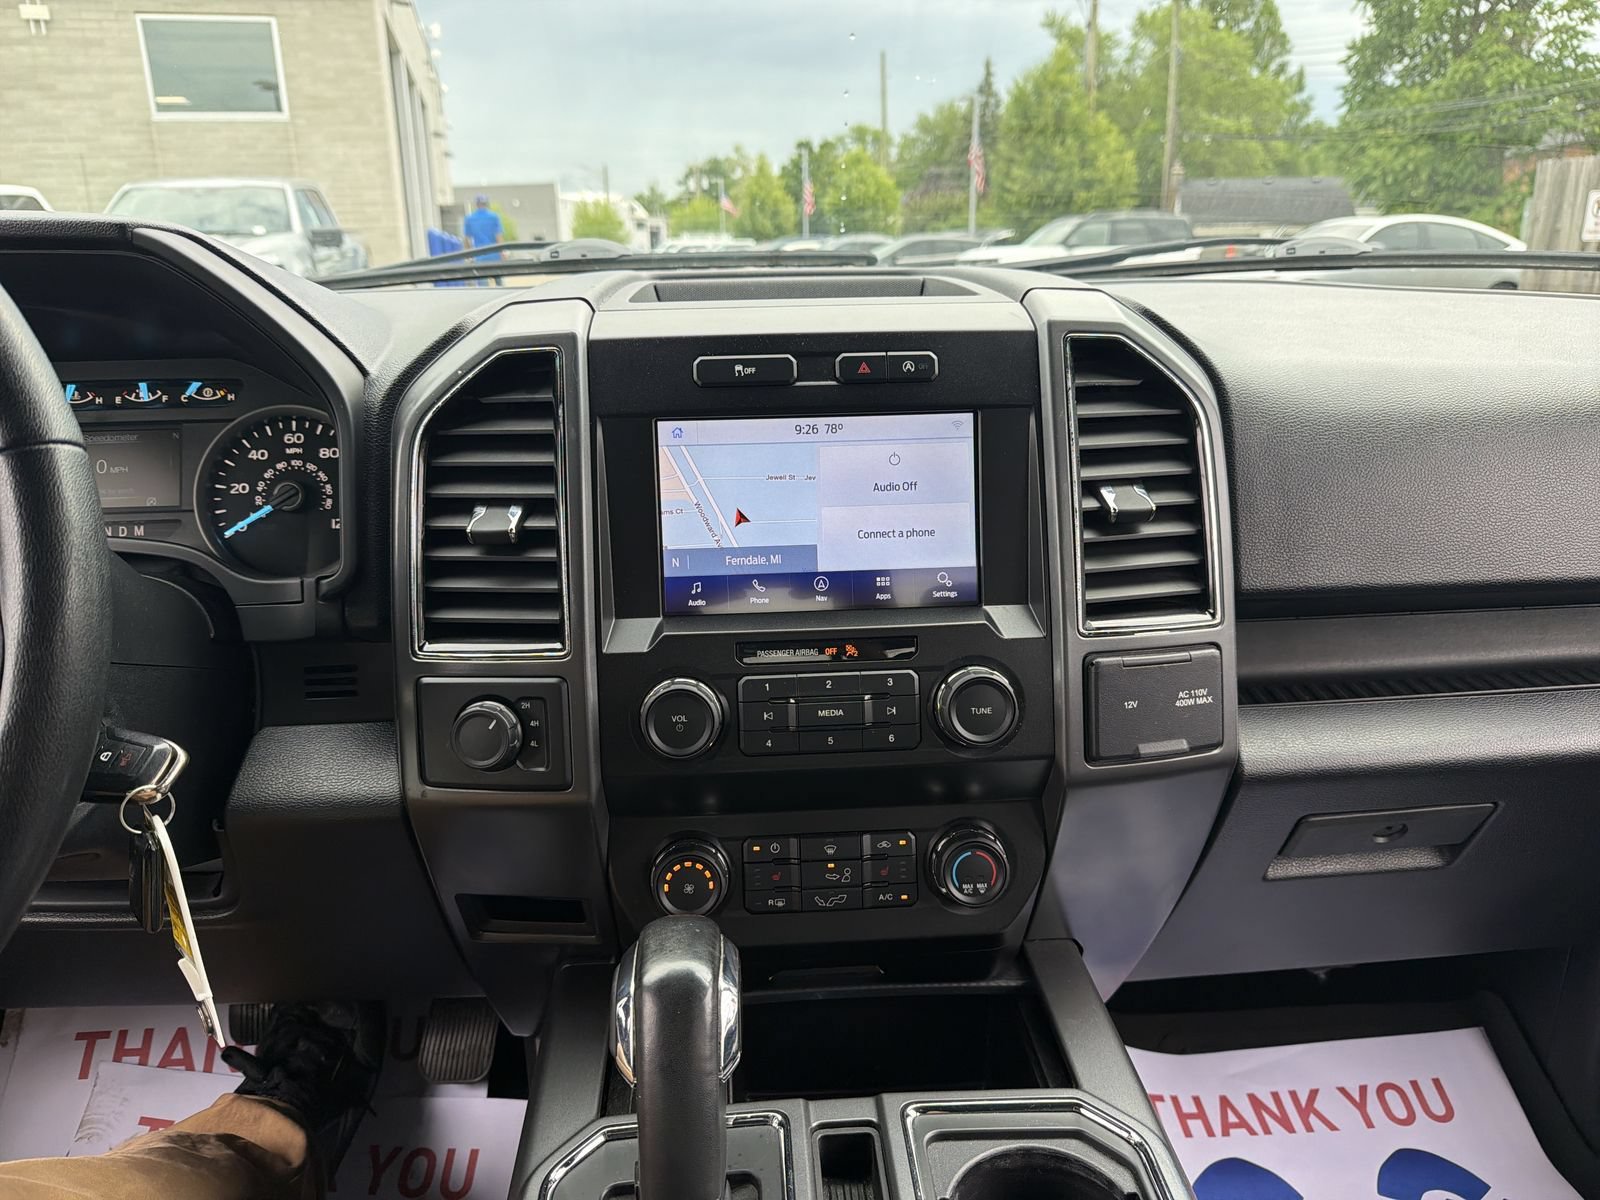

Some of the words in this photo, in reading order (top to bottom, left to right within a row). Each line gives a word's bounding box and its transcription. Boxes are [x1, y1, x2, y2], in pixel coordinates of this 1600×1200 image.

[743, 366, 757, 375] OFF
[95, 396, 103, 405] H
[115, 396, 122, 404] E
[162, 395, 169, 403] F
[180, 394, 189, 403] C
[227, 393, 235, 401] H
[794, 423, 819, 435] 9:26
[283, 432, 305, 444] 60
[247, 449, 269, 460] 40
[285, 447, 303, 455] MPH
[318, 447, 340, 459] 80
[109, 465, 129, 474] MPH
[275, 461, 288, 470] 80
[305, 462, 318, 472] 120
[263, 468, 275, 479] 60
[317, 470, 329, 482] 140
[229, 482, 250, 494] 20
[256, 480, 266, 492] 40
[873, 482, 901, 492] Audio
[902, 481, 918, 491] Off
[675, 507, 684, 515] Ct
[694, 501, 717, 540] Woodward
[118, 526, 128, 537] D
[134, 525, 145, 537] M
[857, 529, 896, 540] Connect
[898, 530, 905, 539] a
[906, 527, 936, 540] phone
[671, 558, 680, 568] N
[725, 554, 769, 566] Ferndale,
[770, 554, 782, 565] MI
[875, 592, 892, 601] Apps
[932, 590, 958, 599] Settings
[688, 599, 707, 607] Audio
[749, 596, 770, 604] Phone
[756, 649, 796, 658] PASSENGER
[795, 648, 819, 657] AIRBAG
[824, 647, 838, 656] OFF
[764, 683, 770, 691] 1
[825, 680, 833, 689] 2
[886, 678, 894, 687] 3
[1177, 690, 1190, 699] AC
[1190, 687, 1208, 698] 110V
[1124, 700, 1139, 709] 12V
[1175, 698, 1195, 707] 400W
[1196, 695, 1214, 705] MAX
[817, 708, 845, 718] MEDIA
[970, 706, 993, 716] TUNE
[671, 714, 689, 723] VOL
[827, 736, 834, 745] 5
[888, 734, 896, 743] 6
[765, 739, 773, 748] 4
[878, 893, 894, 901] A/C
[74, 1027, 243, 1080] THA
[1148, 1088, 1340, 1139] THANK
[1337, 1077, 1456, 1130] YOU
[367, 1144, 481, 1200] YOU
